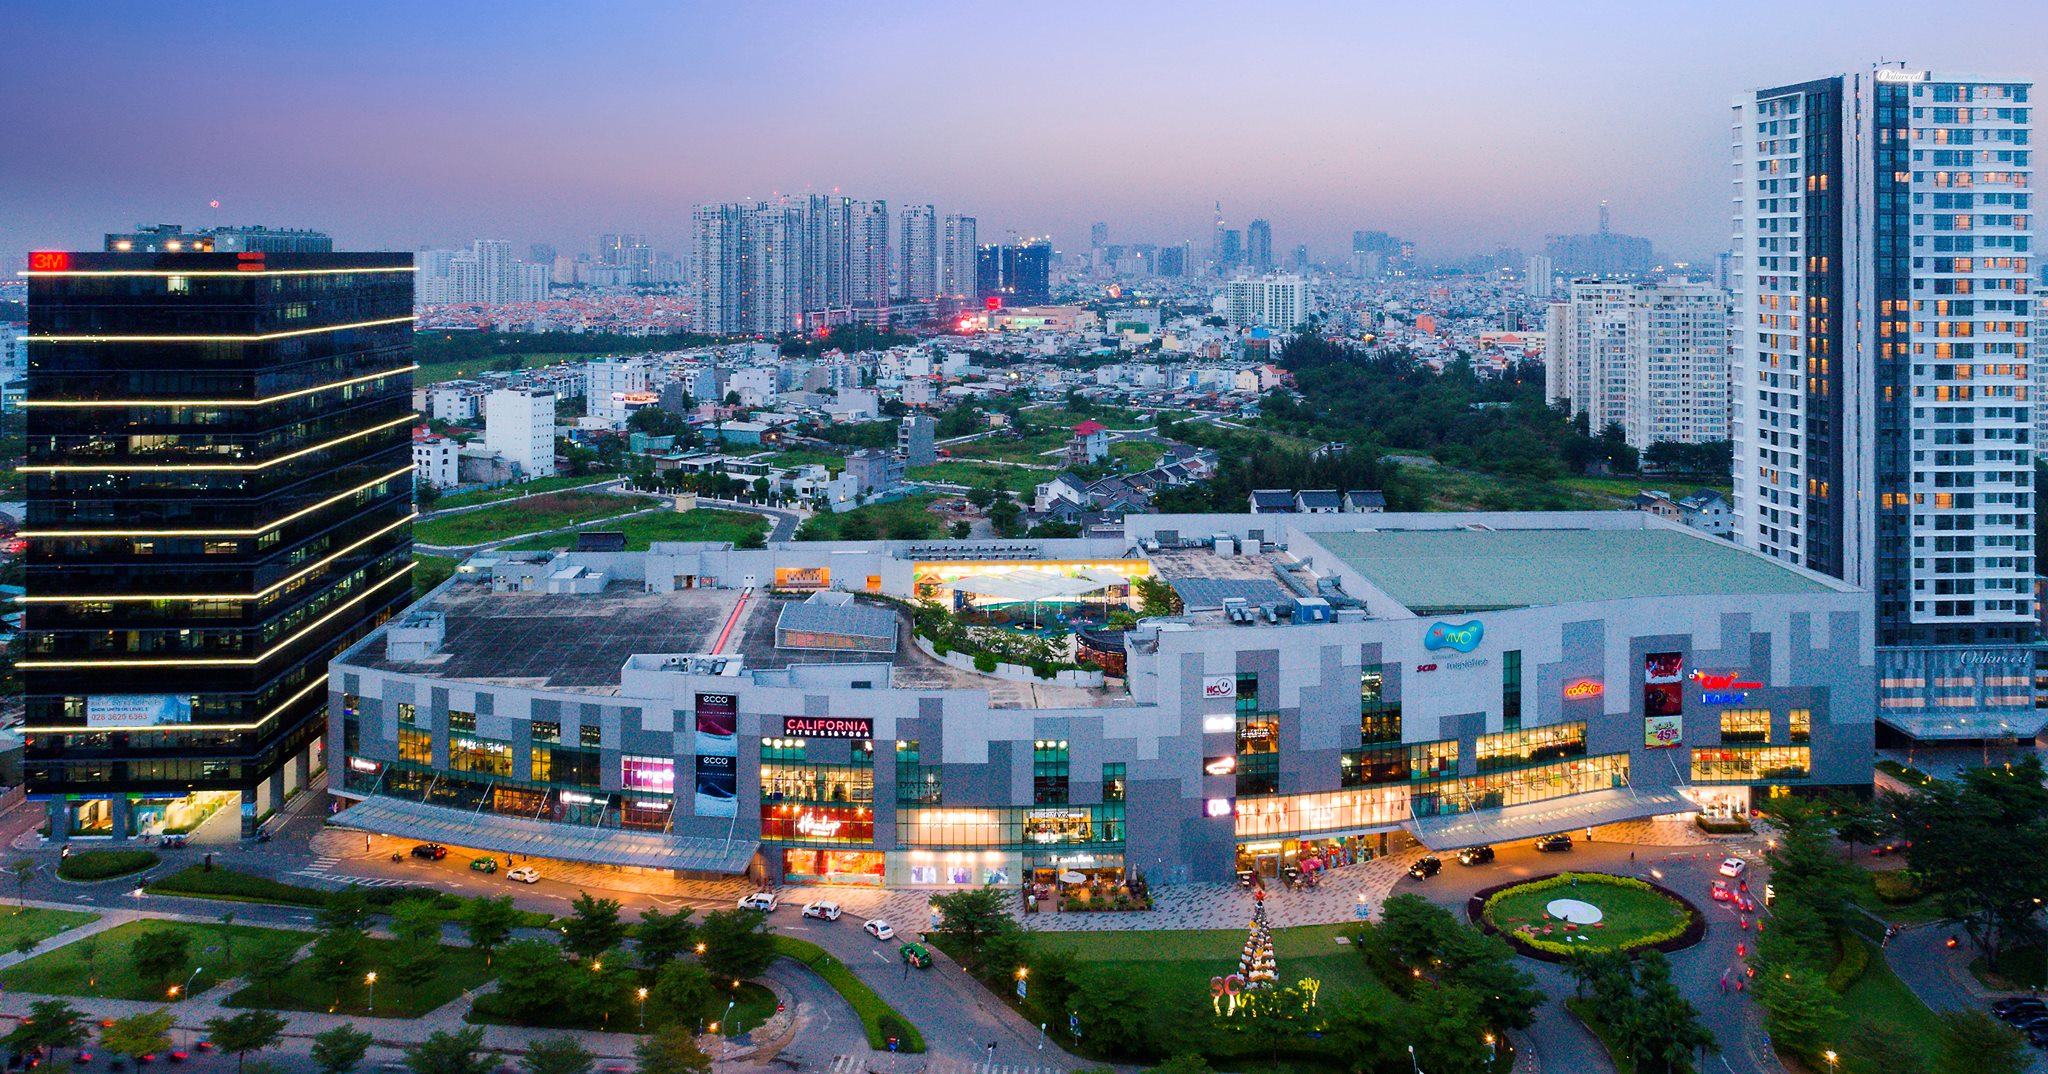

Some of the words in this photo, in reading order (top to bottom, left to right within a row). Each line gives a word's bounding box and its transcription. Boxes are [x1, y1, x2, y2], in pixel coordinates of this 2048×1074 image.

[34, 253, 63, 269] 3M
[1417, 663, 1438, 673] SCID
[1702, 675, 1734, 689] CGV
[703, 695, 728, 703] ecco
[1702, 693, 1746, 704] IMAX
[787, 719, 868, 731] CALIFORNIA
[1211, 974, 1245, 997] SC
